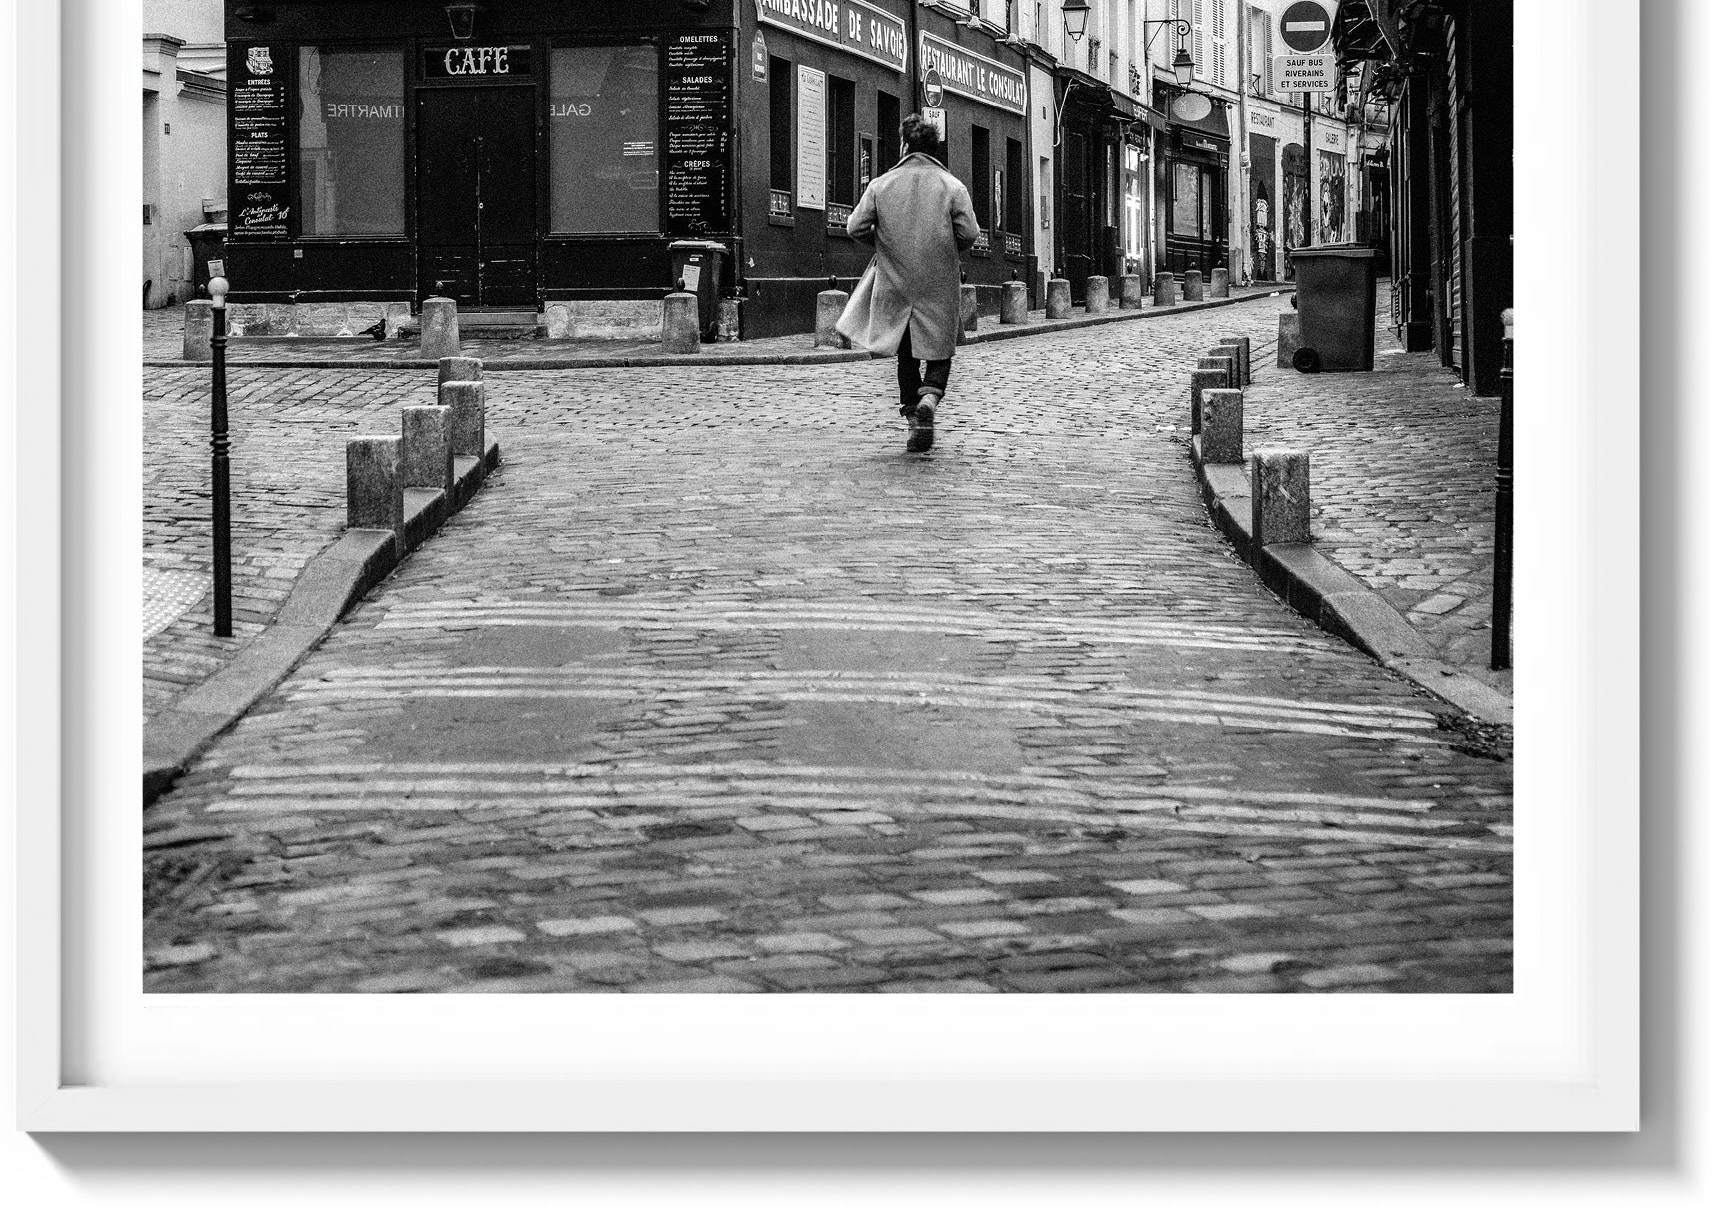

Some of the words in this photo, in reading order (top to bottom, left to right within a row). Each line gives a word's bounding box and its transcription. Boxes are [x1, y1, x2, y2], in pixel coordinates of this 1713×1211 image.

[849, 9, 862, 42] DE
[870, 19, 903, 60] SAVOIE
[679, 35, 718, 43] OMELETTES
[443, 46, 509, 75] CAFE
[1286, 59, 1305, 67] SAUF
[1308, 59, 1323, 67] BUS
[921, 43, 975, 87] RESTAURANT
[976, 66, 986, 92] LE
[989, 71, 1024, 106] CONSULAT
[682, 76, 713, 84] SALADES
[1281, 80, 1290, 88] ET
[1293, 80, 1329, 88] SERVICES
[684, 159, 711, 168] CRÊPES
